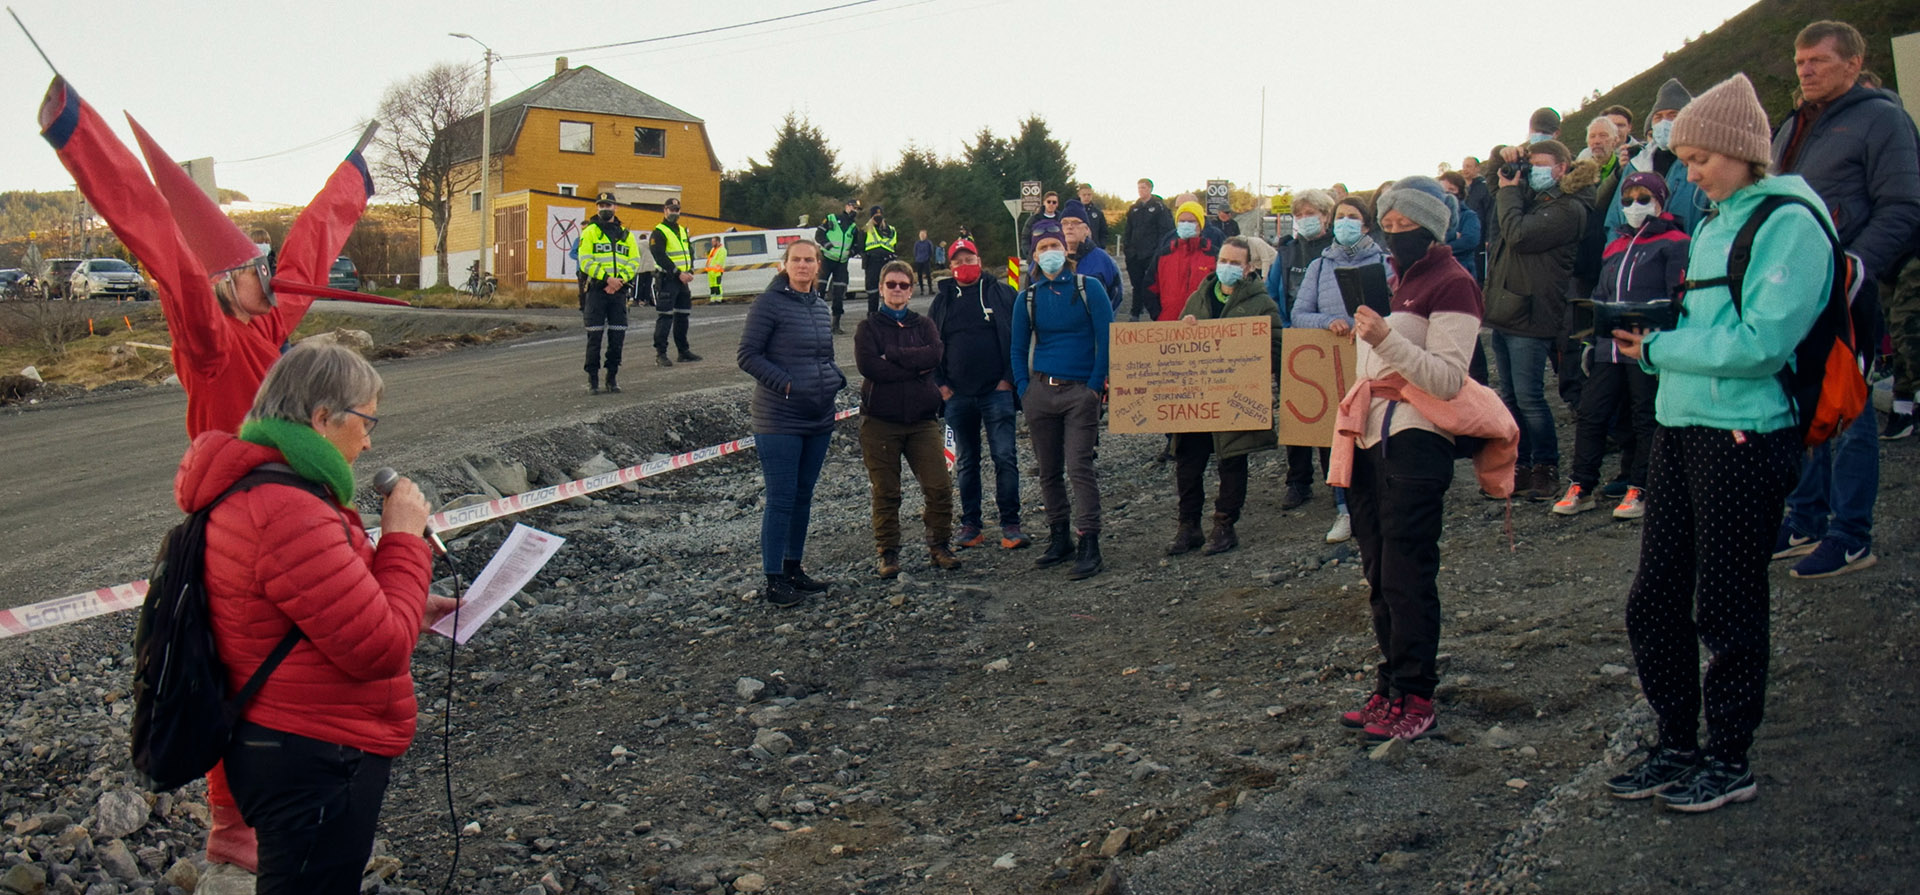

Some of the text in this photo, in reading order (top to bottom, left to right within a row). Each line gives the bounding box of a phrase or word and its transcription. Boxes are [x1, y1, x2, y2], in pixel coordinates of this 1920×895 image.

[1115, 322, 1268, 345] KONSESJONSVEDTAKET ER
[1160, 341, 1210, 355] UGYLDIG
[1115, 396, 1146, 418] POLITIET
[1157, 402, 1220, 421] STANSE
[1226, 397, 1268, 425] VERKSEMD
[1233, 391, 1270, 415] ULOVLEG
